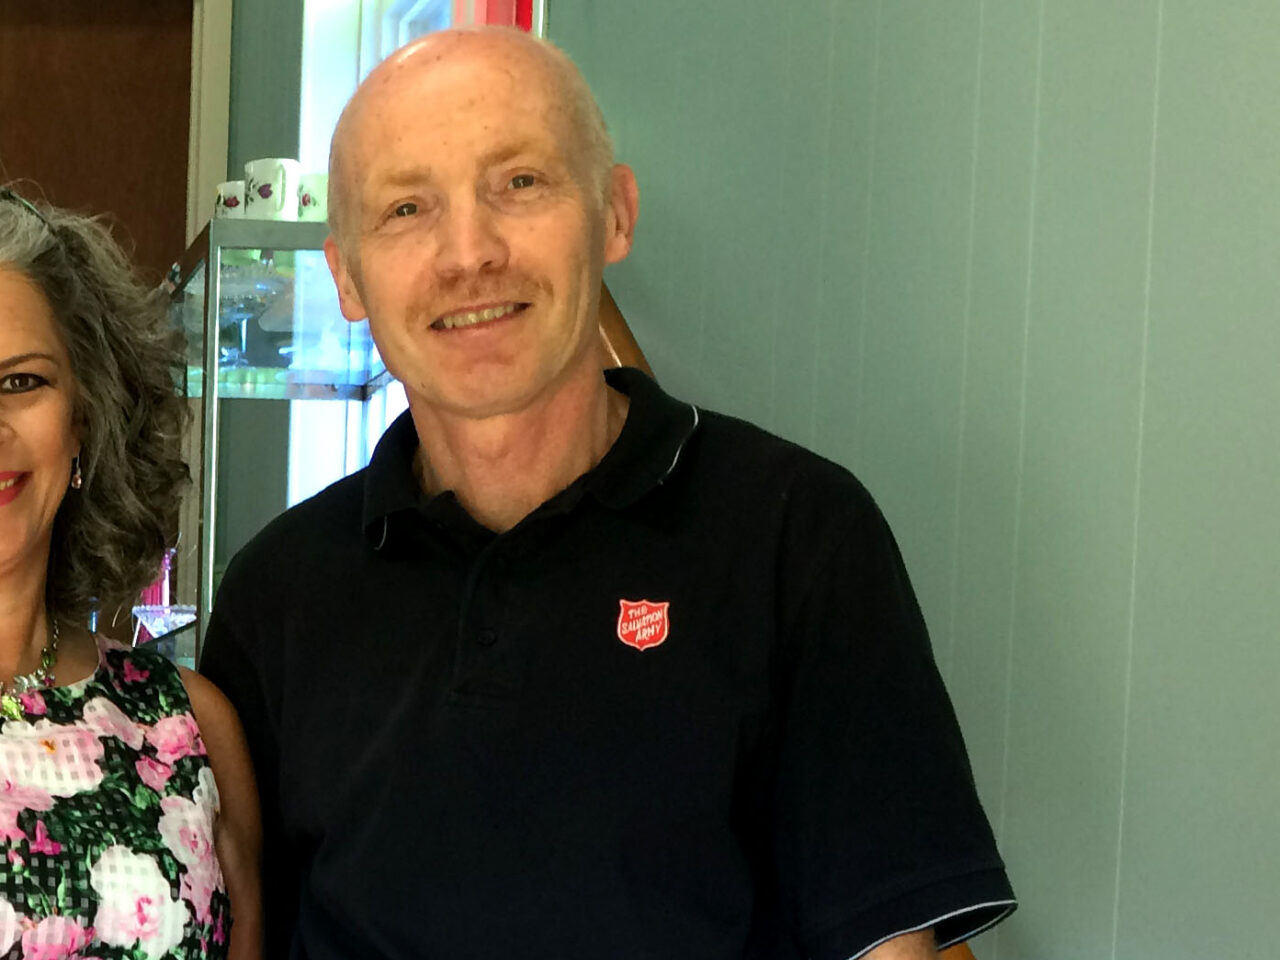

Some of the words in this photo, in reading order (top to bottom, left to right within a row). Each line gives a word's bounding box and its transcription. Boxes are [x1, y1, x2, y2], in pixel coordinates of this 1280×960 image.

[621, 609, 663, 635] SALVATION
[627, 605, 648, 619] THE
[635, 622, 662, 643] ARMY
